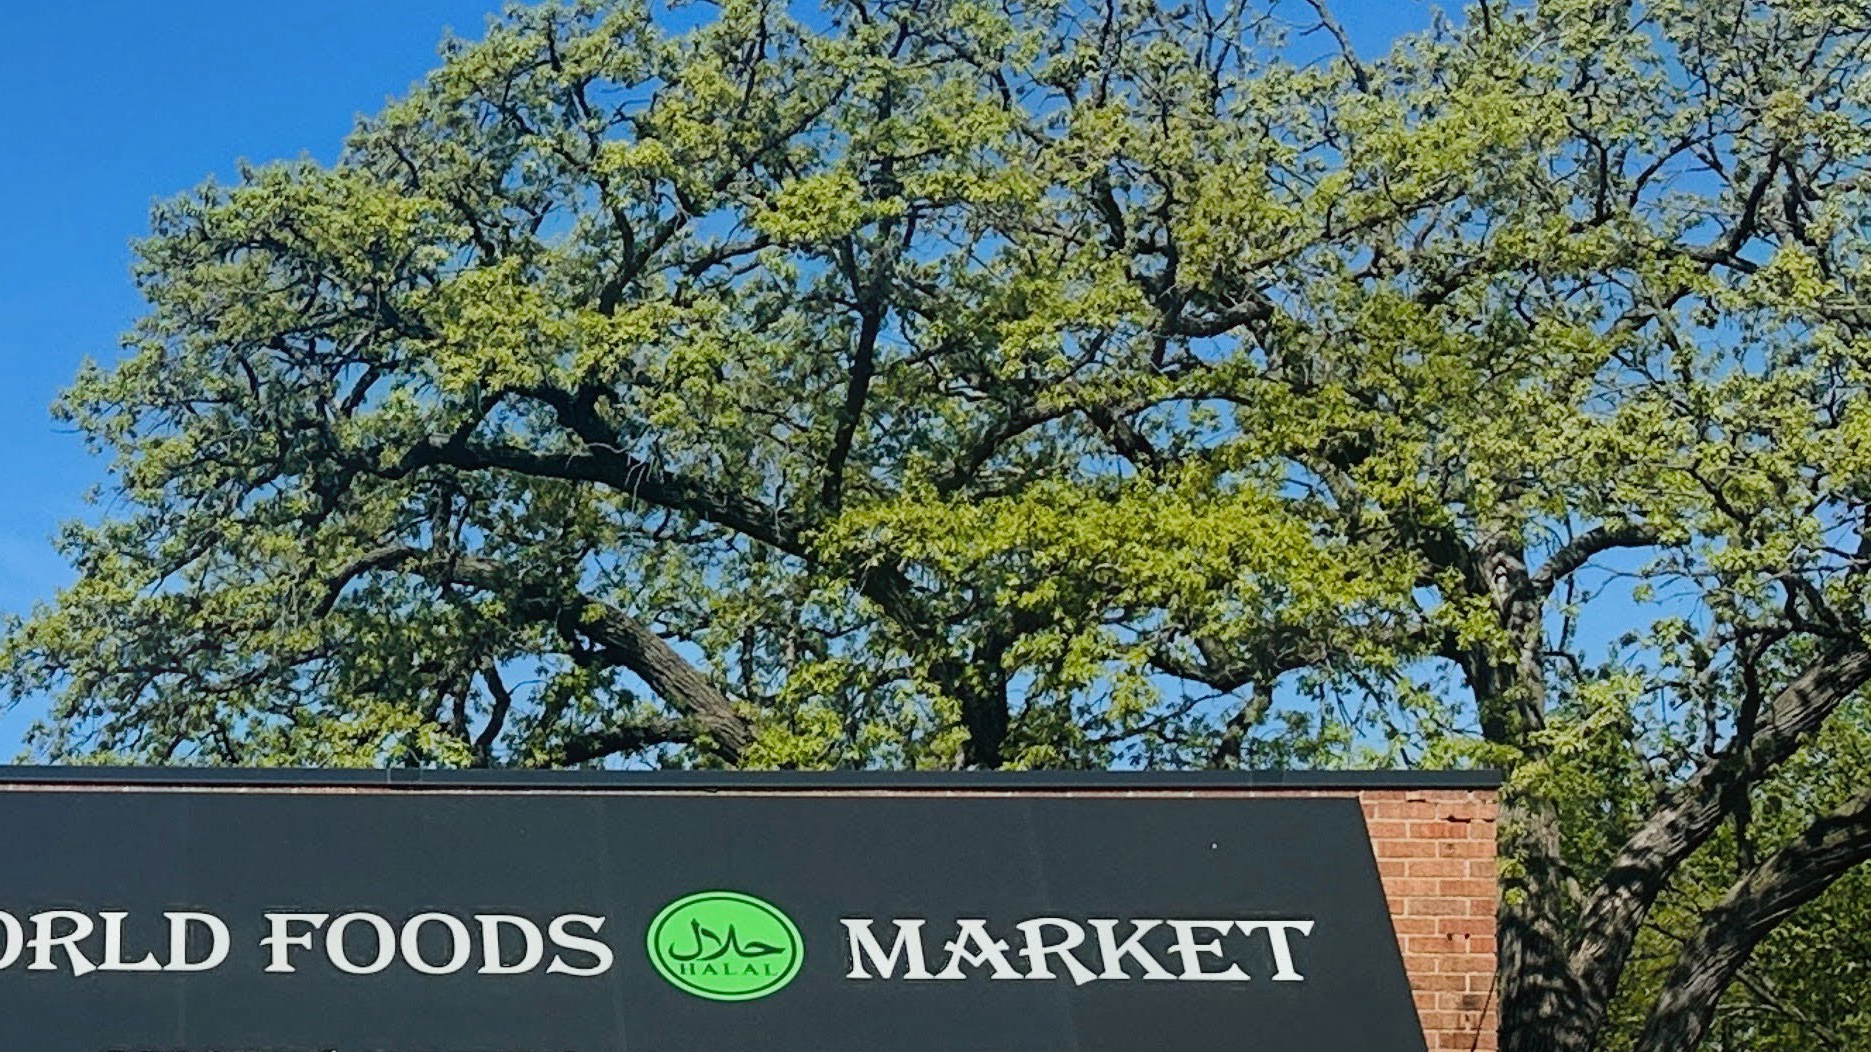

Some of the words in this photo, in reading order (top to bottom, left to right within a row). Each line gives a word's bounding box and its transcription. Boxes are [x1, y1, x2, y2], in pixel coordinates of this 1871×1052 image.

[259, 911, 614, 978] FOODS
[839, 917, 1315, 986] MARKET
[668, 917, 786, 961] حلال
[680, 962, 778, 976] HALAL
